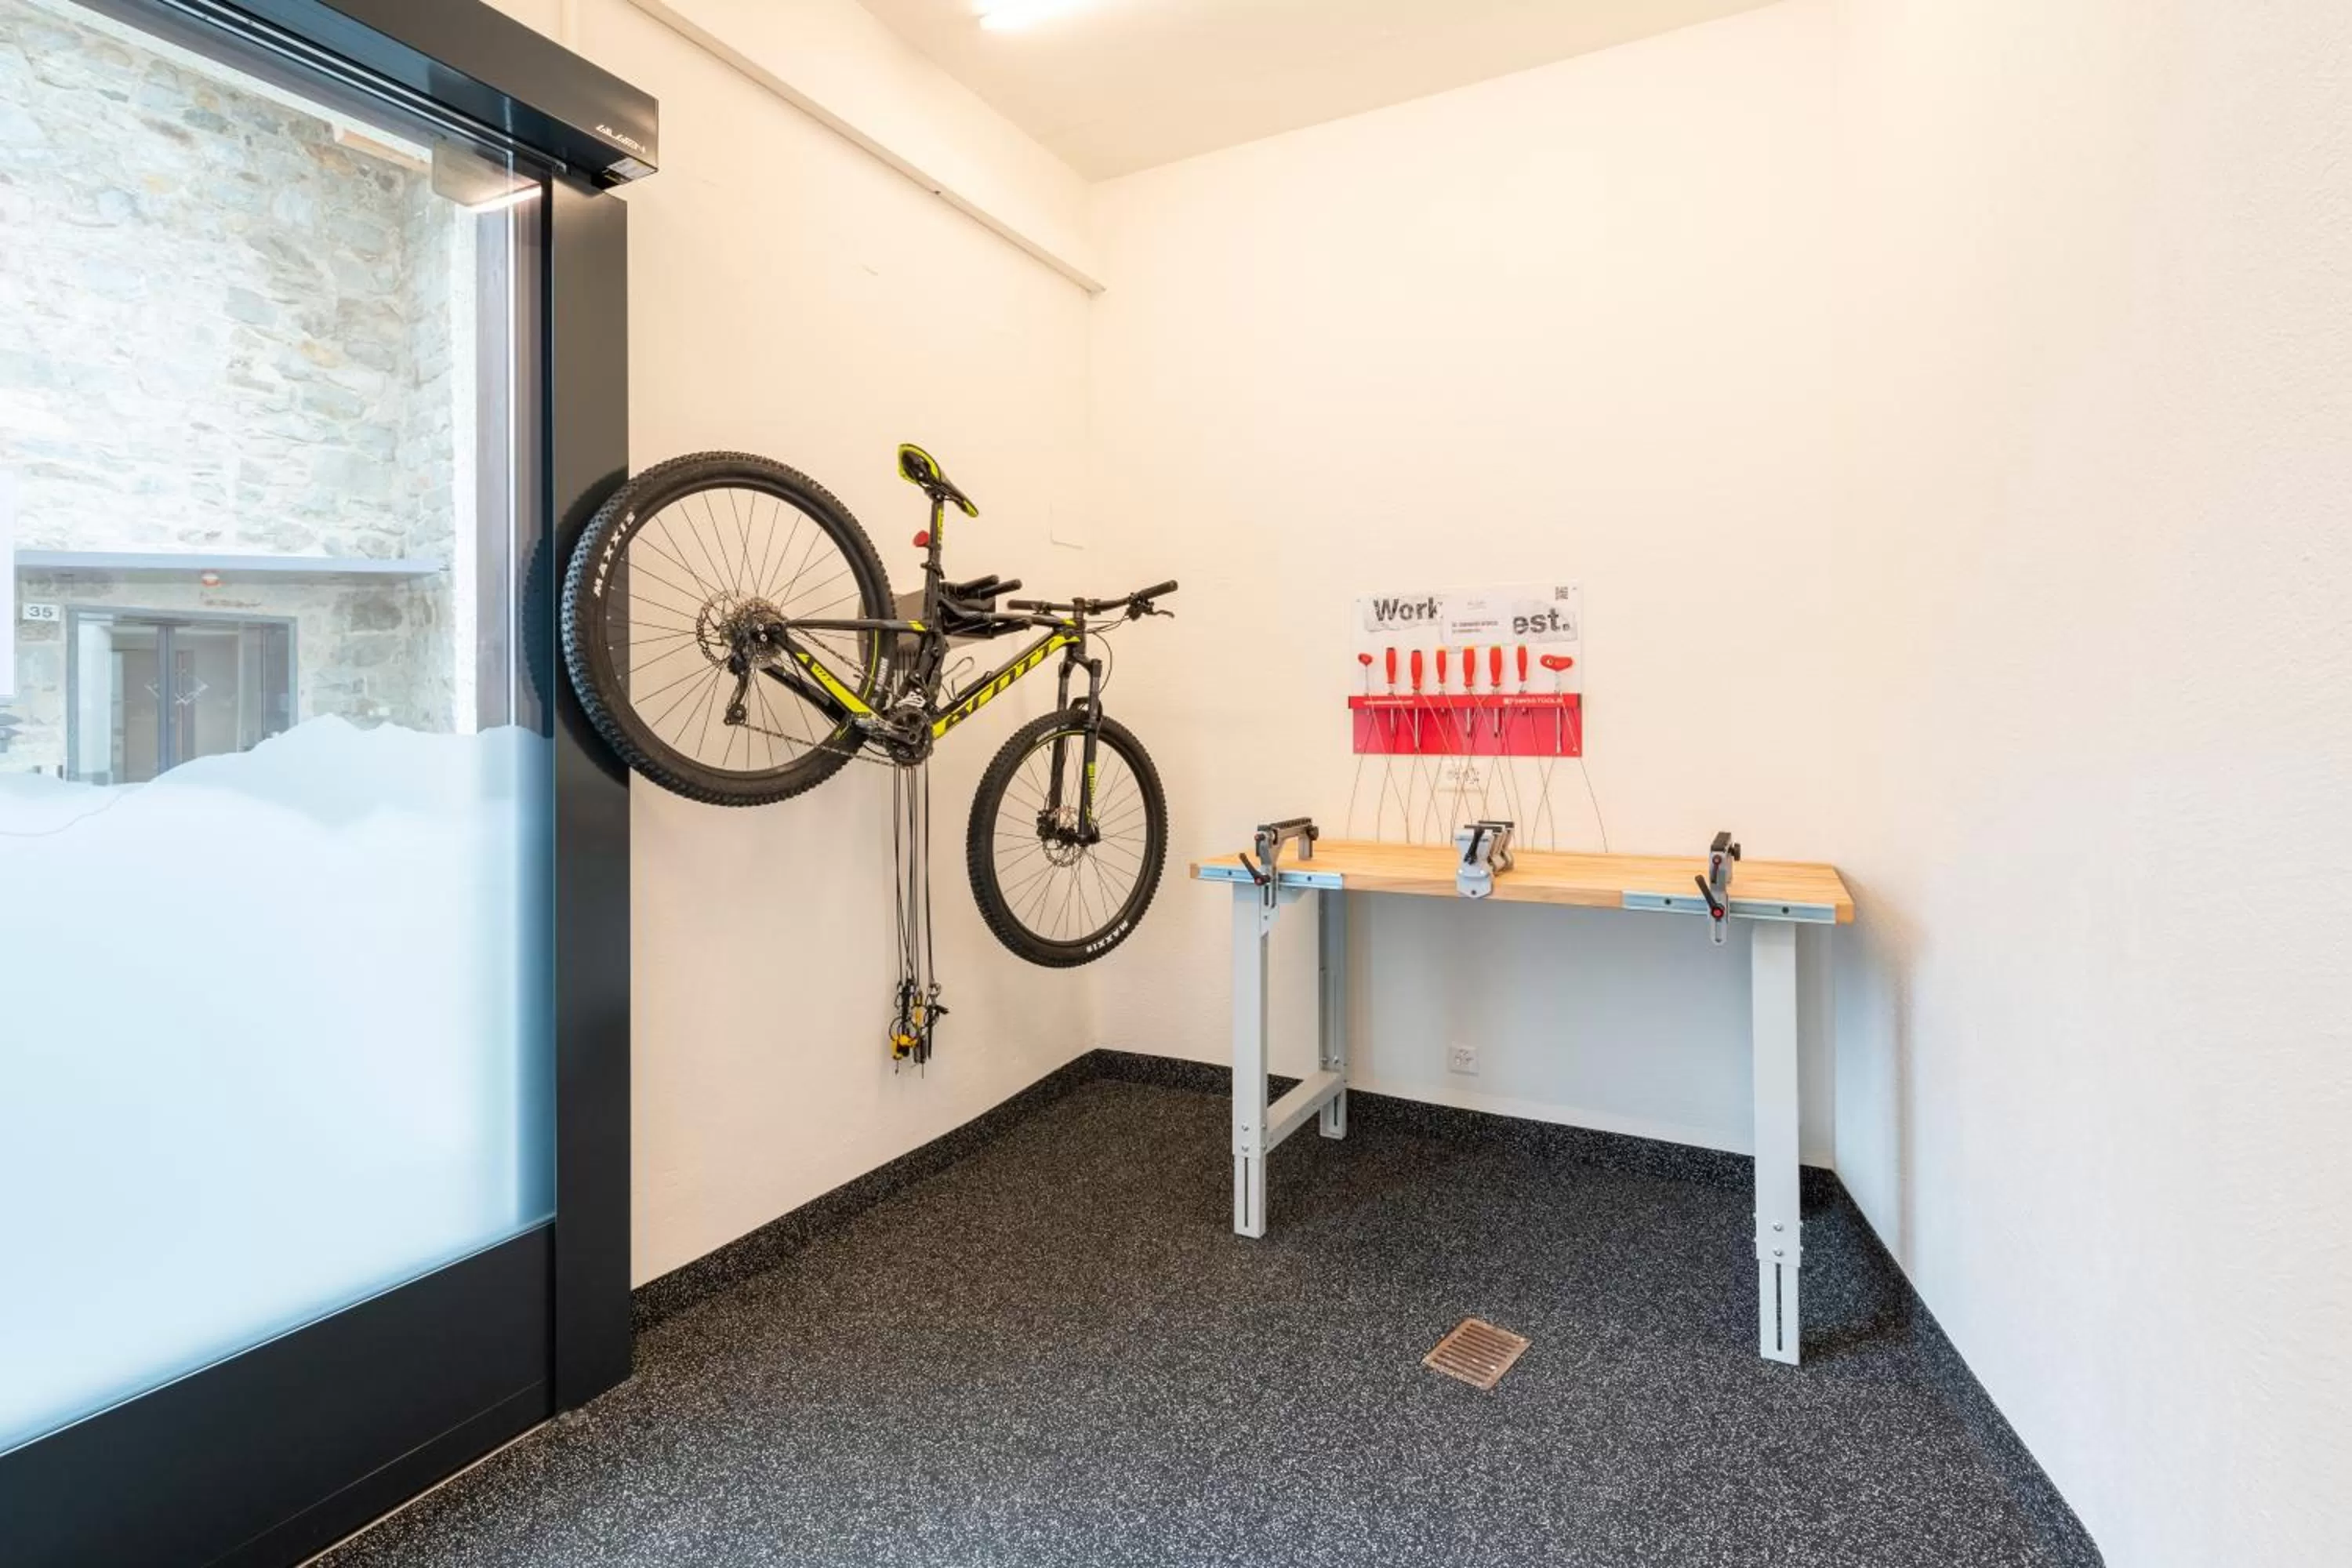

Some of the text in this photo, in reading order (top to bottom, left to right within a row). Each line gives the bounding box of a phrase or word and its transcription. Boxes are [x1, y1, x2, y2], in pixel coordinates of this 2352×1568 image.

[29, 606, 54, 619] 35
[1373, 596, 1570, 635] Work est.
[945, 637, 1055, 731] SCOTT
